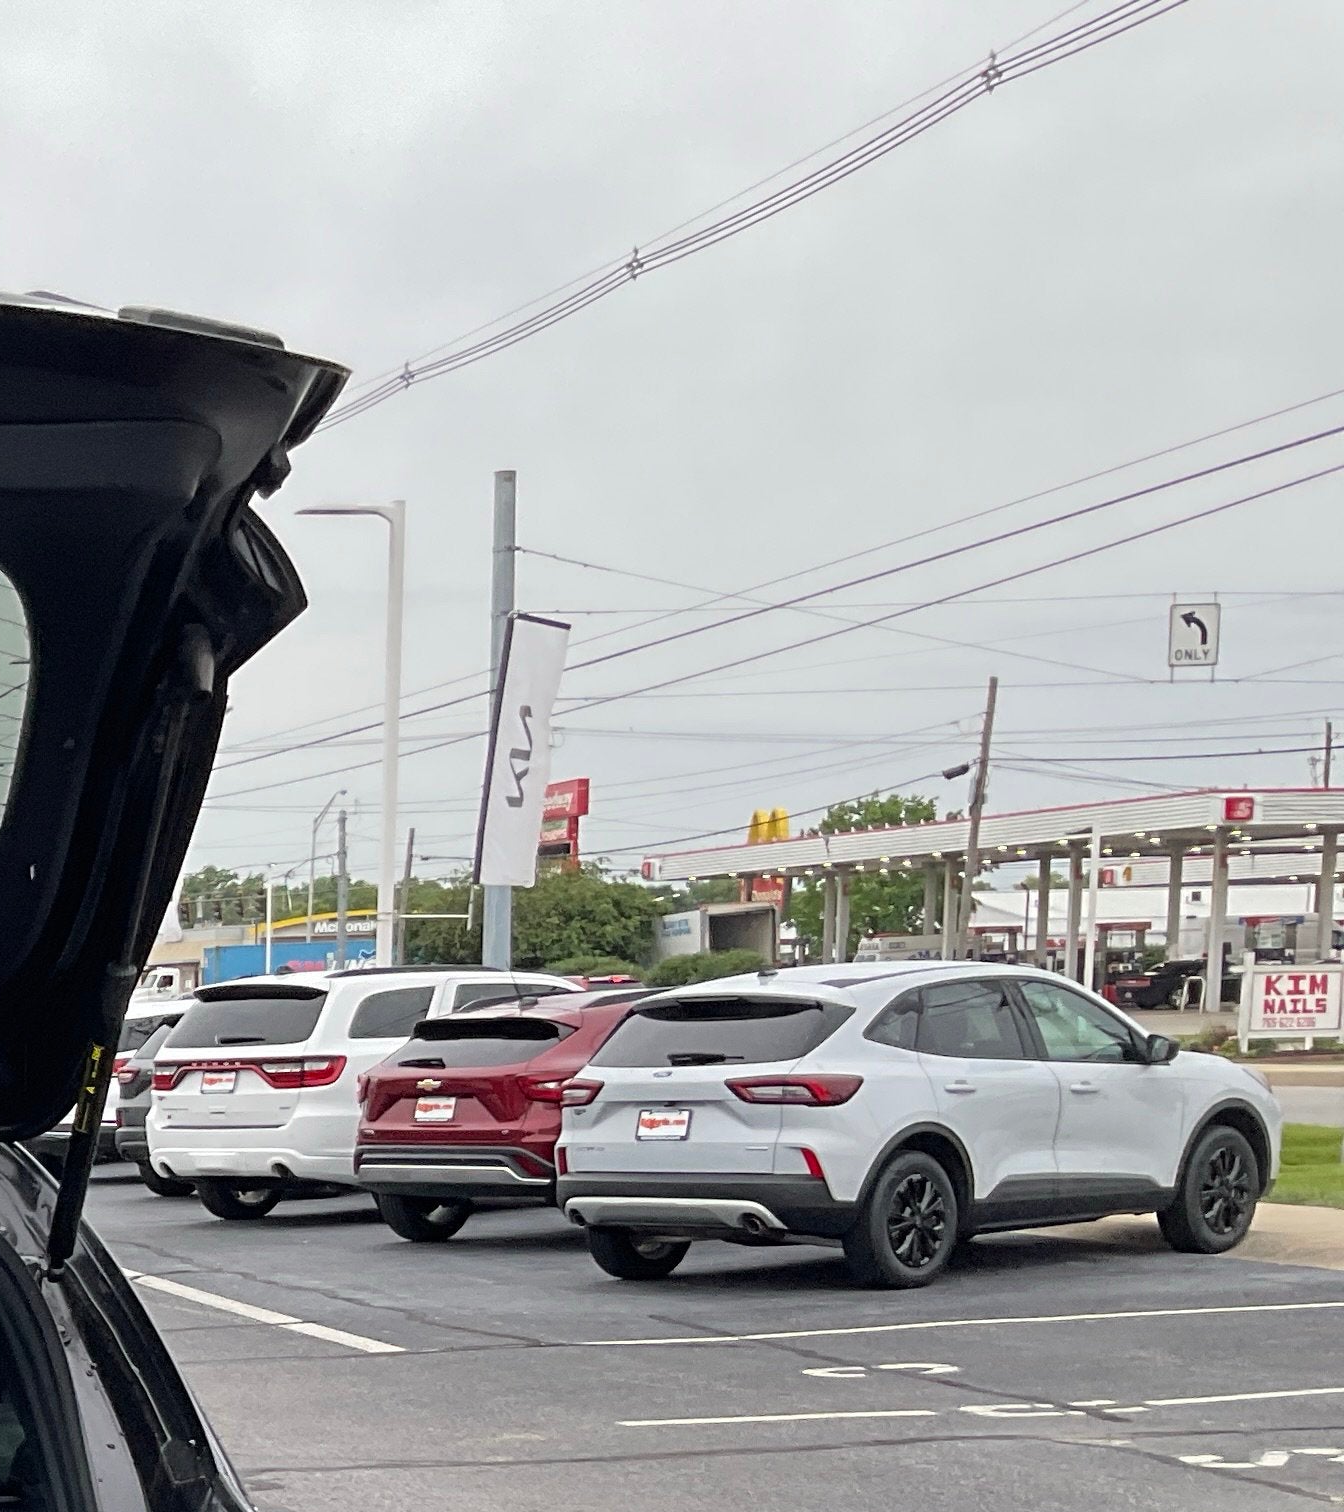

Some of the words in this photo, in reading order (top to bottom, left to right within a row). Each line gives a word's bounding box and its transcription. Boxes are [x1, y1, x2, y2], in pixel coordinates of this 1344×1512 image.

[1174, 648, 1210, 661] ONLY
[1265, 974, 1328, 995] KIM
[1263, 998, 1327, 1014] NAILS
